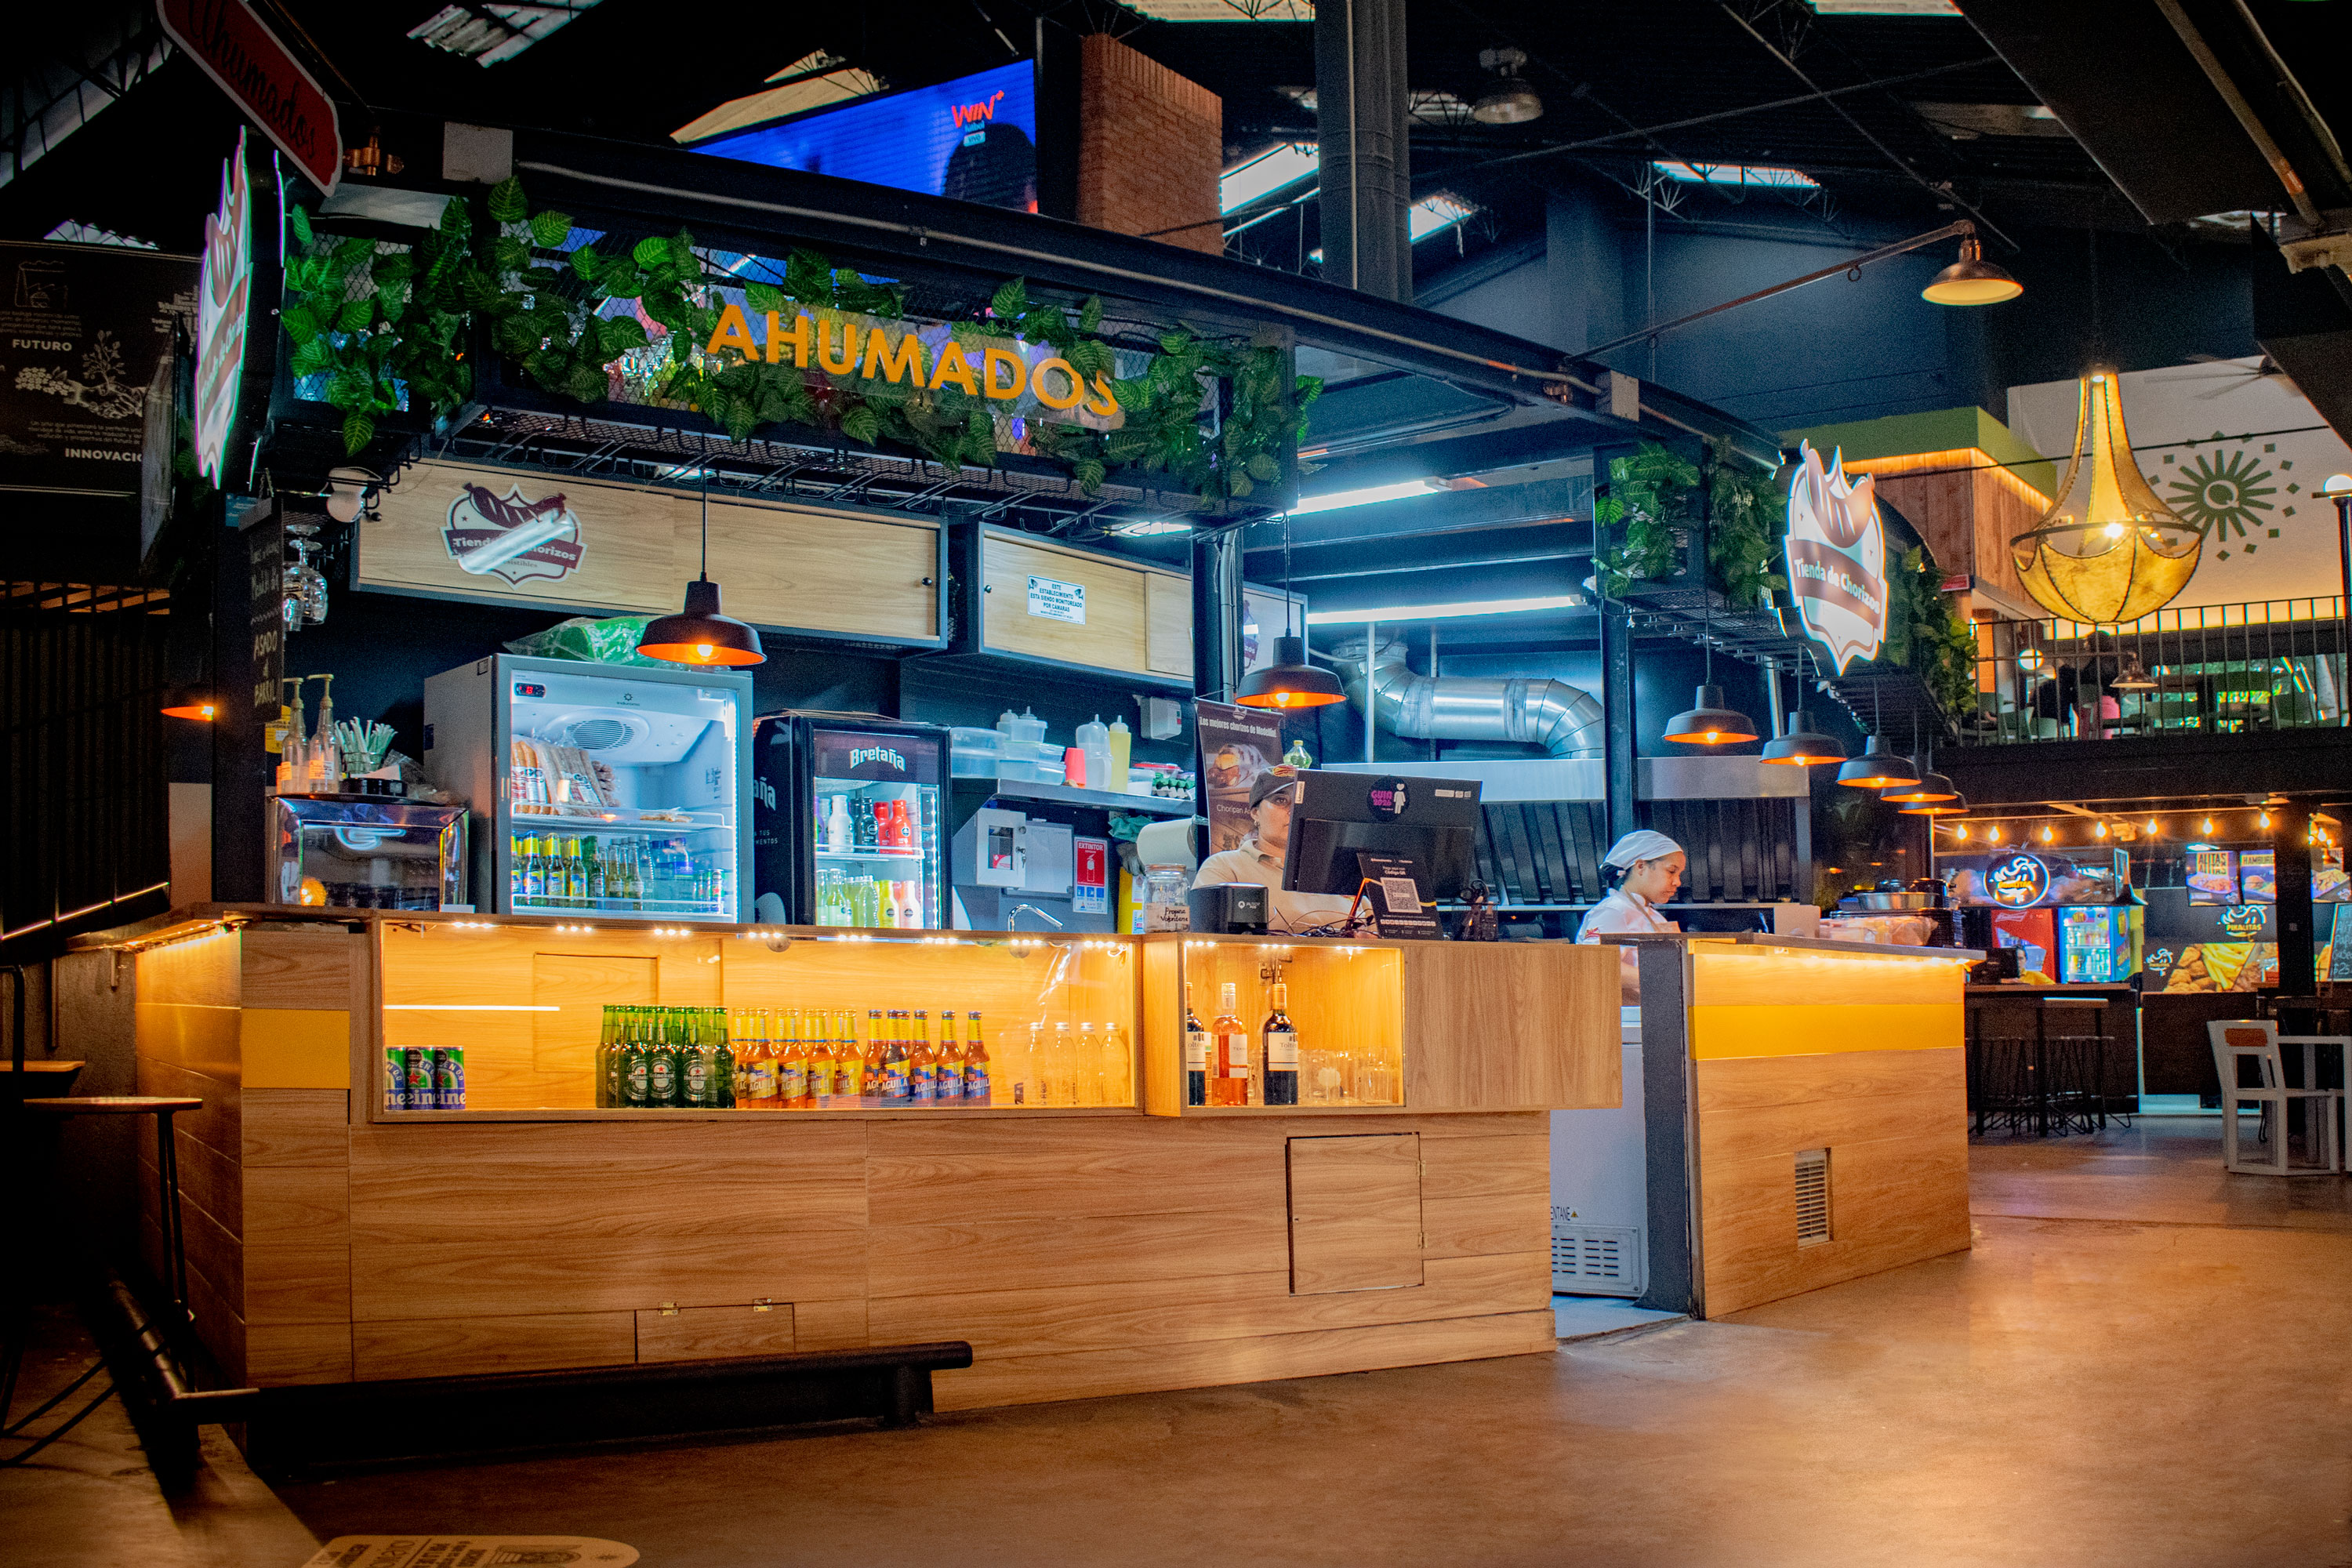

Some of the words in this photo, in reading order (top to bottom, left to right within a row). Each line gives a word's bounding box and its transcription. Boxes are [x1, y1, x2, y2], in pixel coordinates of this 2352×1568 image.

[12, 338, 73, 352] FUTURO
[706, 303, 1120, 417] AHUMADOS
[453, 537, 492, 549] Tiend
[1794, 557, 1826, 582] Tienda
[1827, 565, 1839, 587] de
[1840, 572, 1880, 615] Chorizos
[1039, 587, 1074, 600] ESTABLECIMIENTO
[1055, 597, 1083, 608] MONITOREADO
[1209, 719, 1229, 729] mejores
[1229, 722, 1250, 733] chorizos
[1250, 725, 1256, 734] de
[849, 746, 907, 772] Bretaña
[1078, 842, 1104, 851] EXTINTOR
[2197, 852, 2227, 865] ALITAS
[881, 1078, 908, 1091] AGUILA
[938, 1078, 964, 1092] AGUILA
